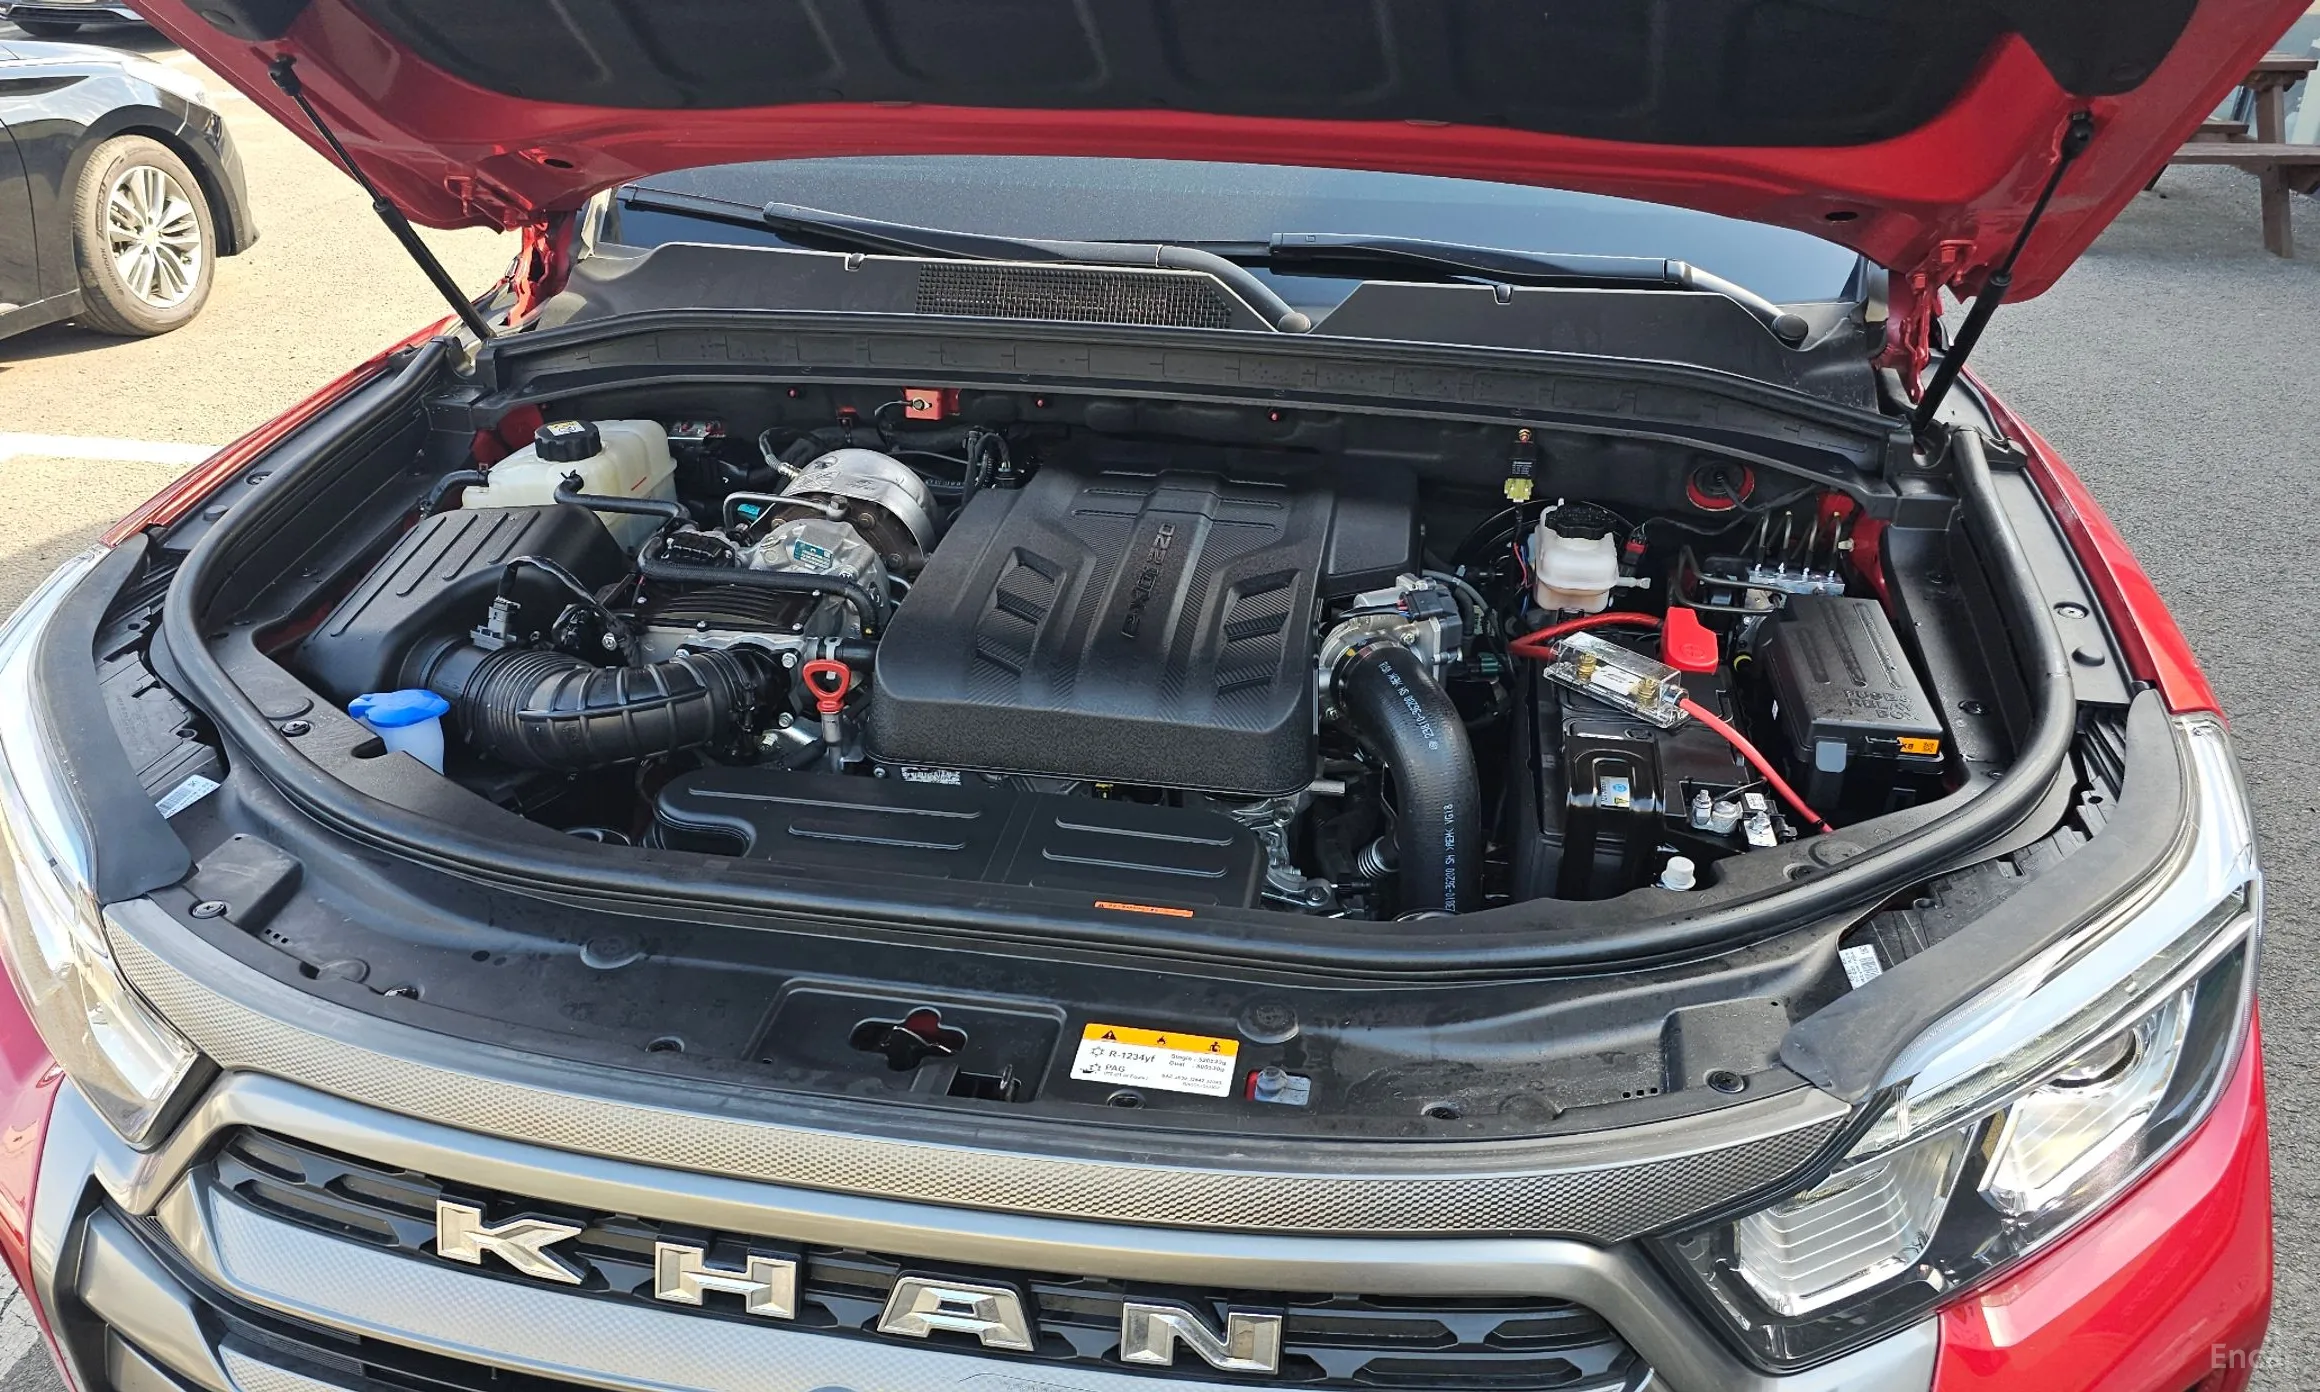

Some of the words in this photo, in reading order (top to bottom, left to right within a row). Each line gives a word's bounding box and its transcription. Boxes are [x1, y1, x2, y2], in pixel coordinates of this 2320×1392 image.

[1108, 1049, 1156, 1063] R-1234yf
[1105, 1063, 1126, 1073] PAG
[436, 1198, 1281, 1375] KHAN
